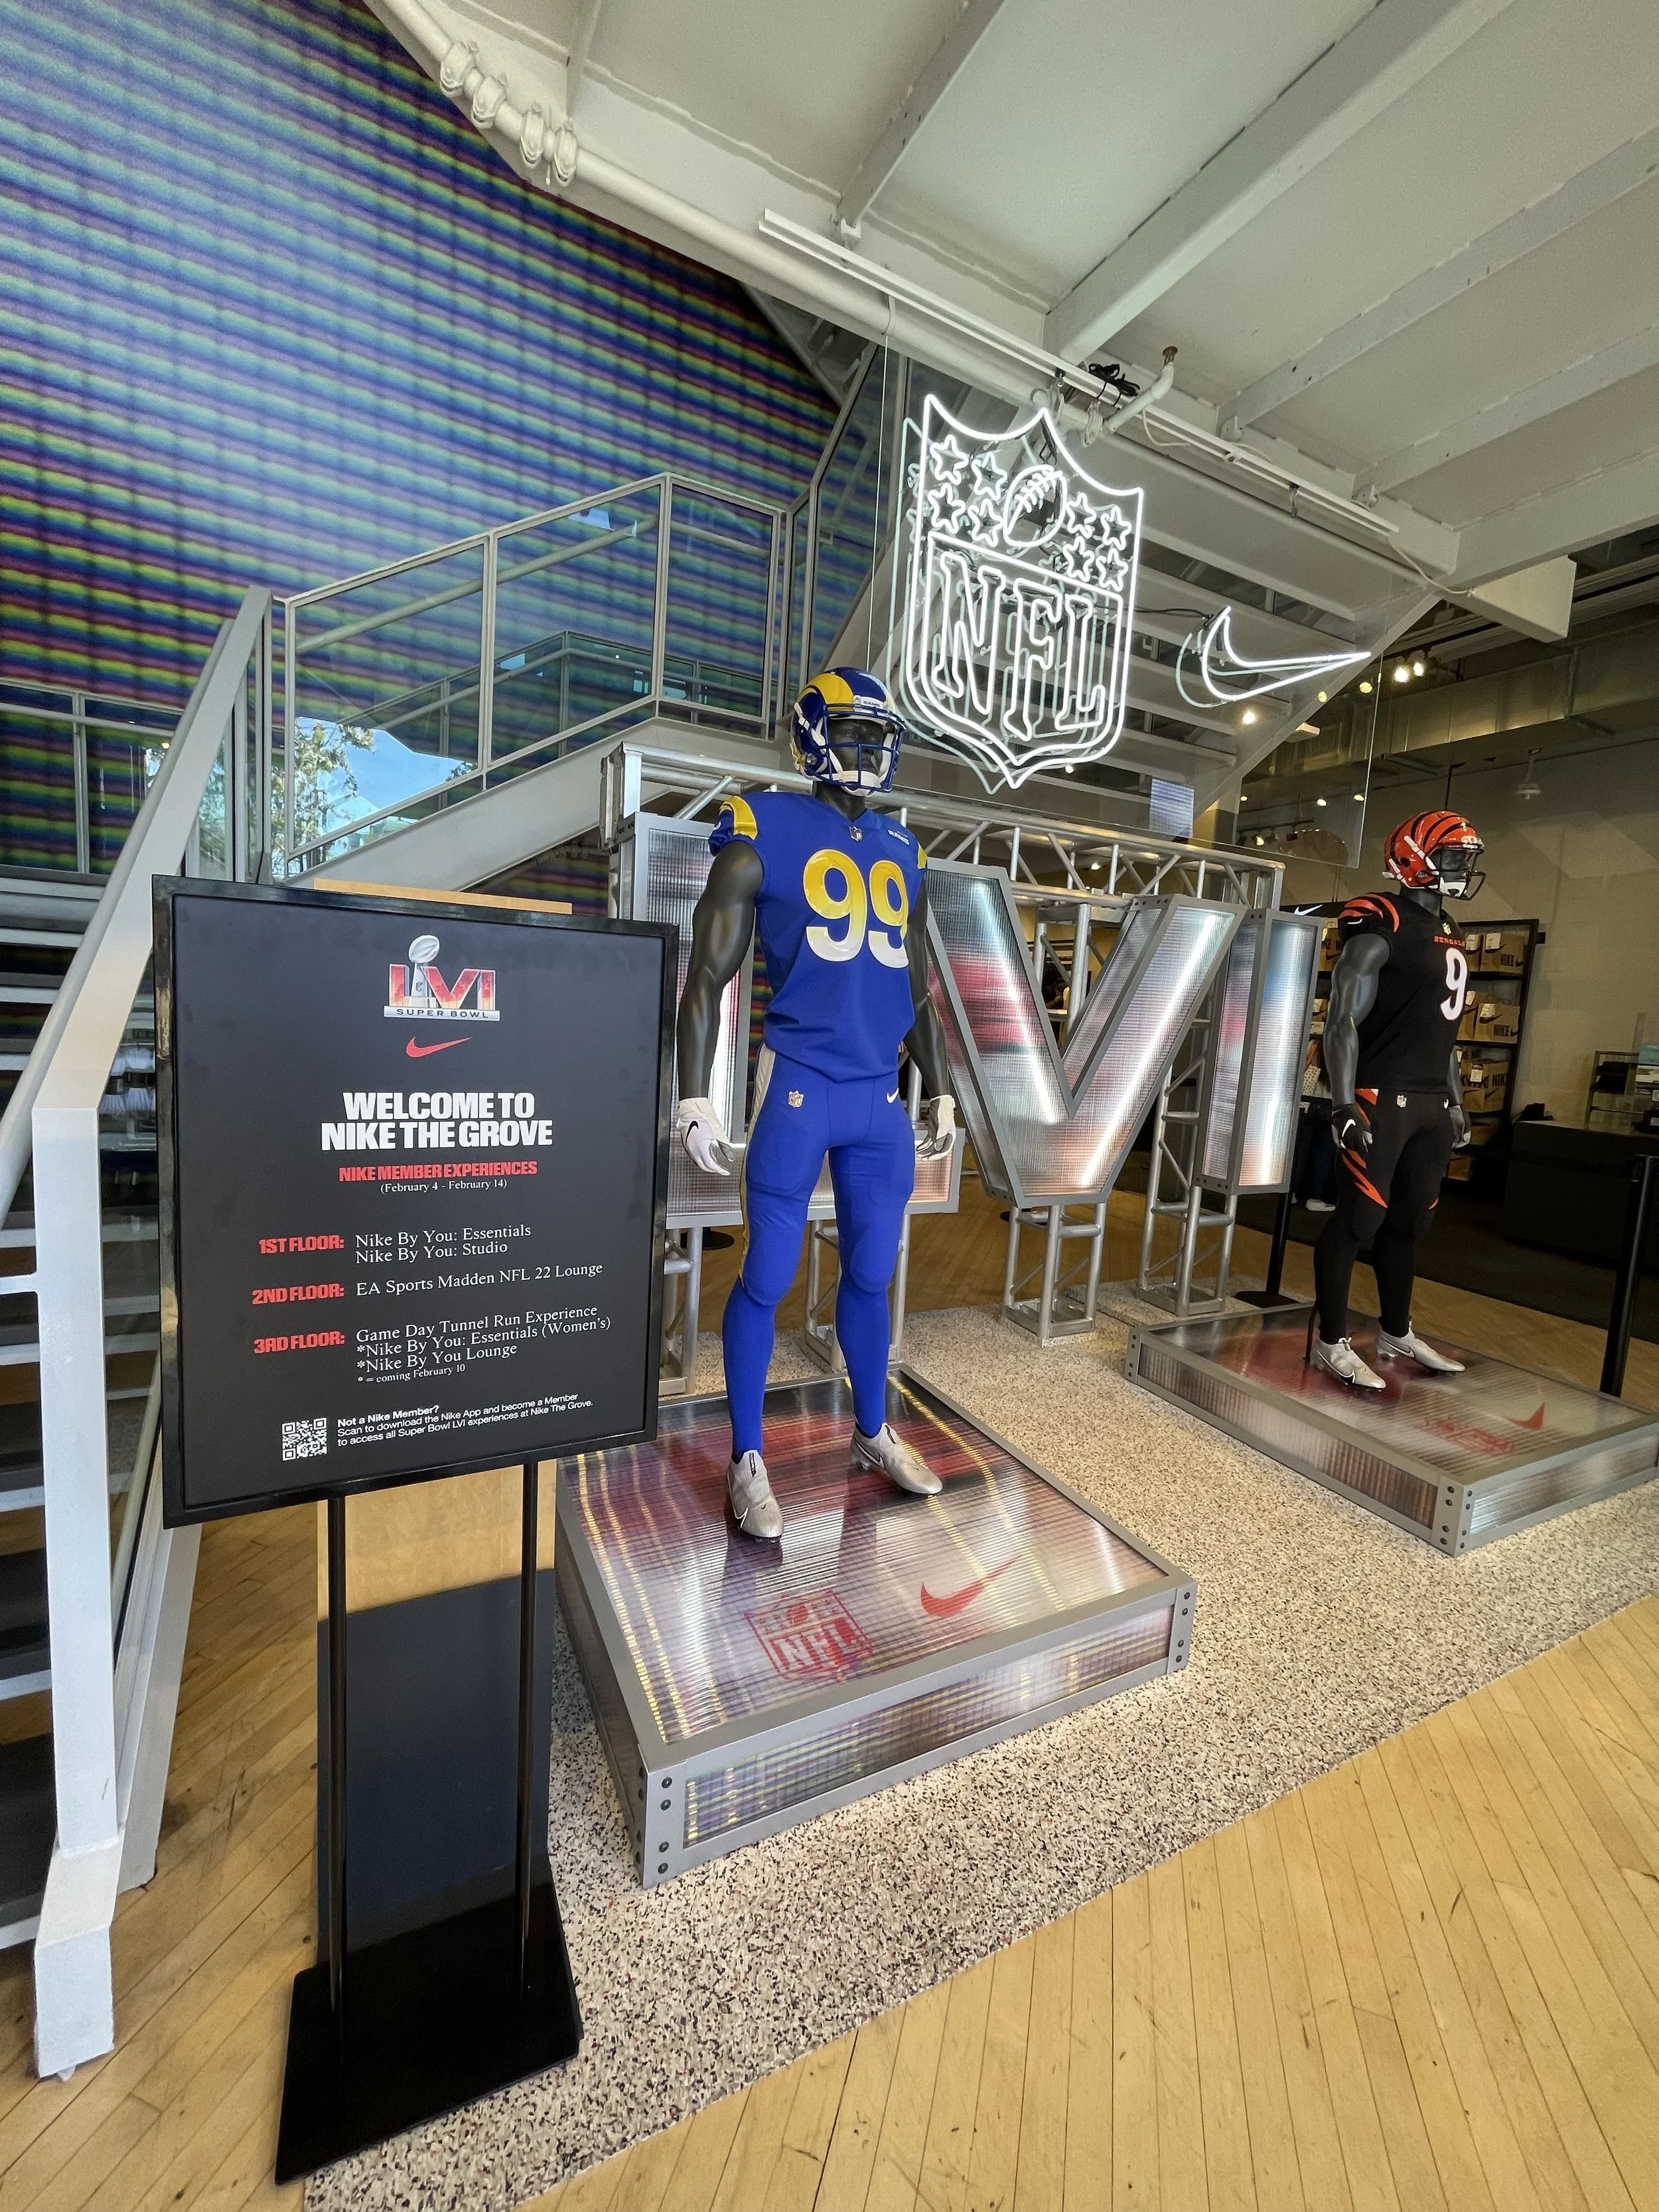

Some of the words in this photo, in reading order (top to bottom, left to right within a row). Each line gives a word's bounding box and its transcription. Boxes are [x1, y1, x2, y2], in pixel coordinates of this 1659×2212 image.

[931, 552, 1106, 743] NFL
[803, 849, 909, 968] 99
[389, 964, 496, 1011] LVI
[1439, 947, 1468, 1021] 9
[396, 1008, 444, 1017] SUPER
[342, 1092, 494, 1120] WELCOME
[498, 1092, 535, 1119] TO
[321, 1122, 396, 1151] NIKE
[399, 1121, 456, 1149] THE
[459, 1120, 553, 1147] GROVE
[339, 1166, 376, 1182] NIKE
[377, 1164, 443, 1181] MEMBER
[443, 1161, 538, 1179] EXPERIENCES
[380, 1182, 430, 1195] (February
[431, 1182, 439, 1191] 4
[448, 1179, 491, 1191] February
[492, 1177, 508, 1189] 14)
[258, 1238, 287, 1254] 1ST
[289, 1234, 345, 1252] FLOOR:
[356, 1233, 393, 1248] Nike
[397, 1232, 418, 1248] By
[423, 1230, 458, 1244] You:
[463, 1224, 532, 1241] Essentials
[356, 1250, 393, 1264] Nike
[397, 1248, 418, 1264] By
[423, 1245, 458, 1259] You:
[463, 1240, 508, 1256] Studio
[252, 1287, 288, 1305] 2ND
[289, 1283, 345, 1302] FLOOR:
[356, 1282, 381, 1296] EA
[386, 1279, 434, 1296] Sports
[437, 1272, 495, 1289] Madden
[499, 1268, 530, 1282] NFL
[534, 1266, 551, 1280] 22
[555, 1264, 603, 1278] Lounge
[253, 1337, 289, 1354] 3RD
[290, 1330, 346, 1350] FLOOR:
[356, 1329, 401, 1343] Game
[405, 1323, 435, 1339] Day
[439, 1316, 489, 1333] Tunnel
[494, 1315, 521, 1327] Run
[525, 1306, 598, 1325] Experience
[407, 1339, 427, 1354] By
[432, 1335, 466, 1350] You:
[470, 1325, 538, 1345] Essentials
[541, 1316, 611, 1339] (Women's)
[376, 1373, 411, 1384] coming
[413, 1366, 454, 1379] February
[456, 1363, 466, 1373] 10
[407, 1355, 427, 1369] By
[432, 1350, 461, 1365] You
[466, 1345, 518, 1361] Lounge
[337, 1418, 357, 1428] Not
[367, 1413, 391, 1424] Nike
[392, 1404, 440, 1420] Member?
[337, 1427, 362, 1438] Scan
[364, 1425, 375, 1434] to
[376, 1415, 423, 1431] download
[425, 1414, 439, 1424] the
[441, 1411, 461, 1422] Nike
[463, 1409, 481, 1420] App
[482, 1404, 500, 1415] and
[501, 1400, 536, 1412] become
[544, 1394, 579, 1405] Member
[337, 1438, 348, 1447] to
[350, 1433, 384, 1445] access
[386, 1430, 396, 1439] all
[398, 1426, 426, 1437] Super
[427, 1421, 451, 1433] Bowl
[453, 1419, 466, 1429] LVI
[467, 1412, 519, 1427] experiences
[520, 1409, 529, 1418] at
[530, 1406, 549, 1416] Nike
[551, 1403, 566, 1413] The
[567, 1399, 594, 1410] Grove.
[772, 1623, 859, 1670] NFL
